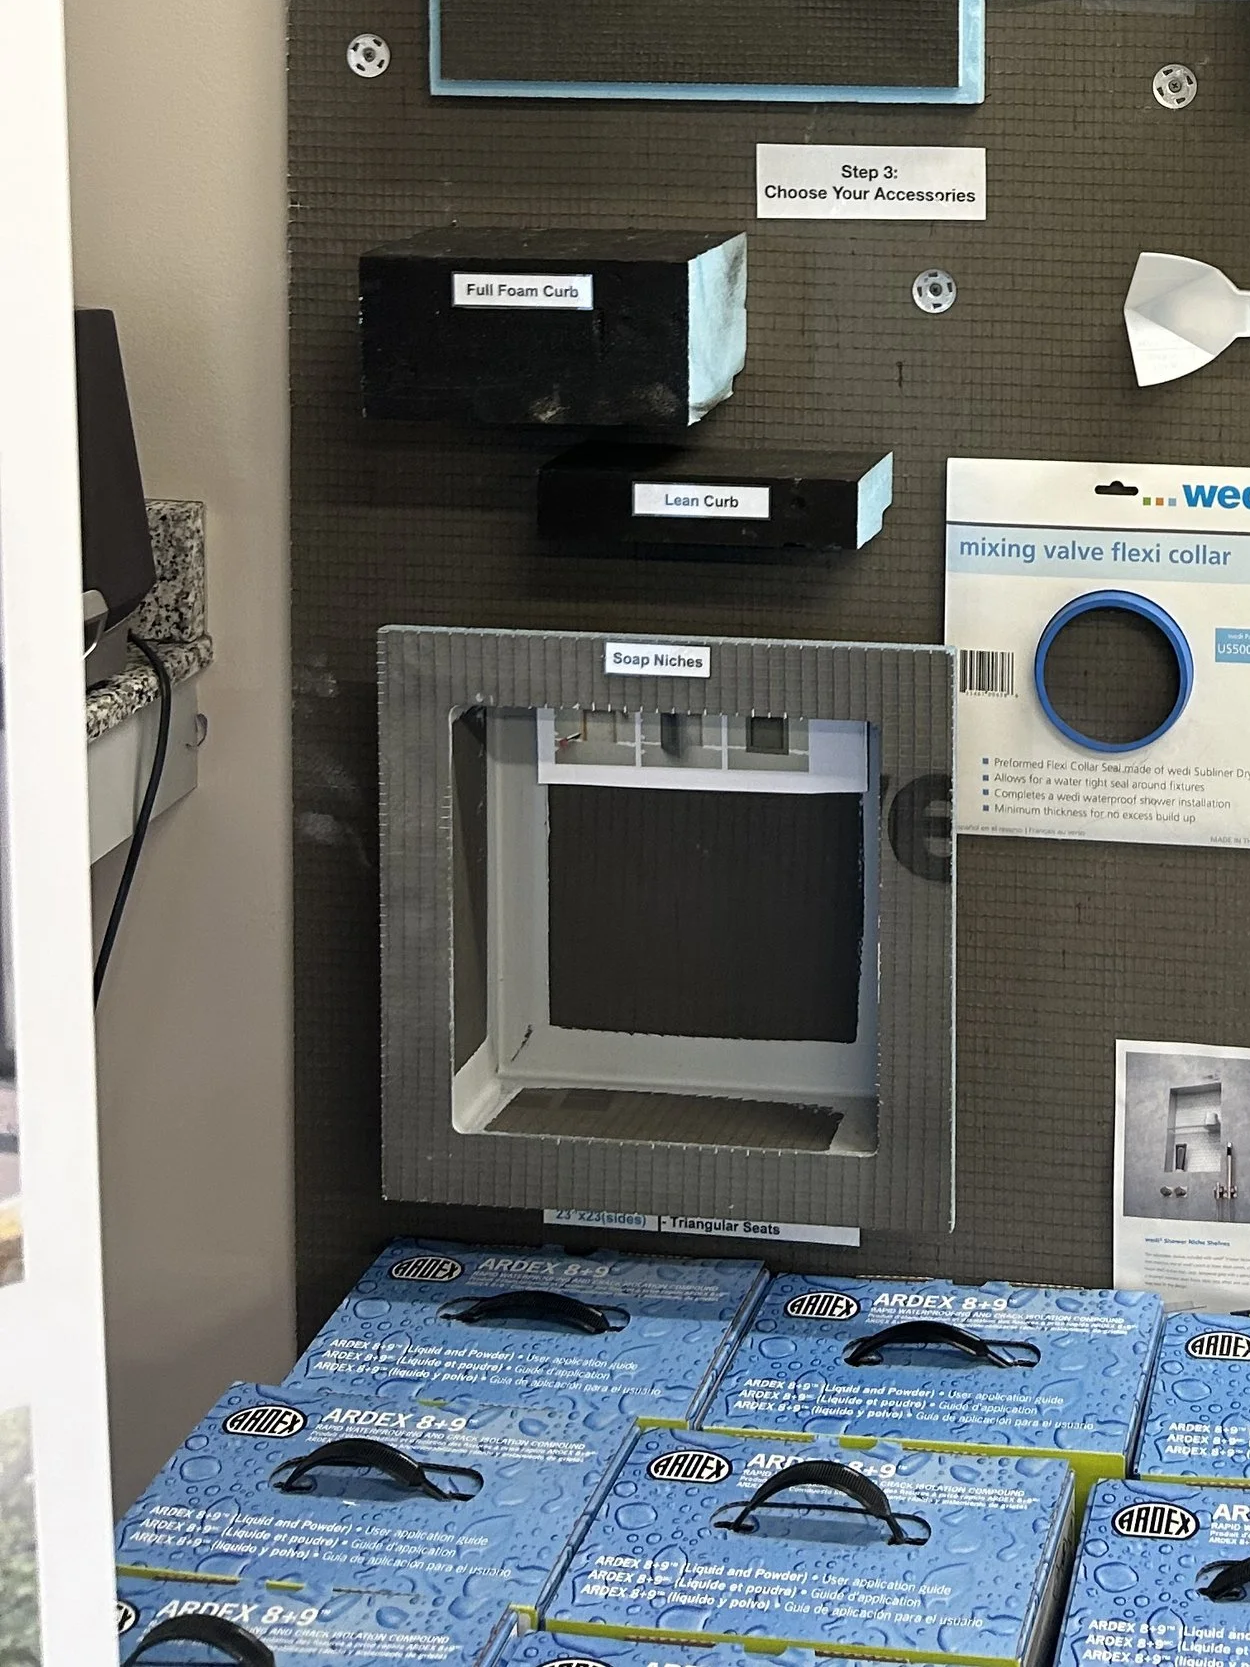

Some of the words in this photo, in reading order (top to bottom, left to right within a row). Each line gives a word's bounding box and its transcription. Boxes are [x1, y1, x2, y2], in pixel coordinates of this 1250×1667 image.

[842, 165, 879, 182] Step
[884, 166, 897, 179] 3:
[765, 185, 827, 199] Choose
[833, 186, 870, 200] Your
[874, 187, 976, 202] Accessories
[467, 284, 493, 296] Full
[498, 284, 538, 297] Foam
[543, 285, 579, 298] Curb
[666, 494, 699, 507] Lean
[704, 495, 739, 508] Curb
[960, 537, 1035, 563] mixing
[1044, 540, 1104, 561] valve
[1111, 542, 1160, 563] flexi
[1169, 545, 1231, 565] collar
[614, 652, 650, 668] Soap
[654, 654, 703, 668] Niches
[994, 758, 1044, 769] Preformed
[1047, 760, 1067, 770] Flexi
[1070, 761, 1099, 772] Collar
[1103, 763, 1121, 774] Seal
[1126, 765, 1152, 776] made
[1154, 766, 1164, 775] of
[1168, 766, 1191, 776] wedi
[1195, 767, 1233, 777] Subliner
[670, 1217, 739, 1233] Triangular
[743, 1222, 781, 1235] Seats
[392, 1259, 459, 1279] ARDEX
[790, 1295, 857, 1318] ARDEX
[874, 1293, 952, 1310] ARDEX
[228, 1411, 303, 1435] ARDEX
[654, 1454, 728, 1480] ARDEX
[1119, 1506, 1196, 1536] ARDEX
[822, 1574, 849, 1586] User
[853, 1578, 915, 1594] application
[918, 1583, 951, 1596] guide
